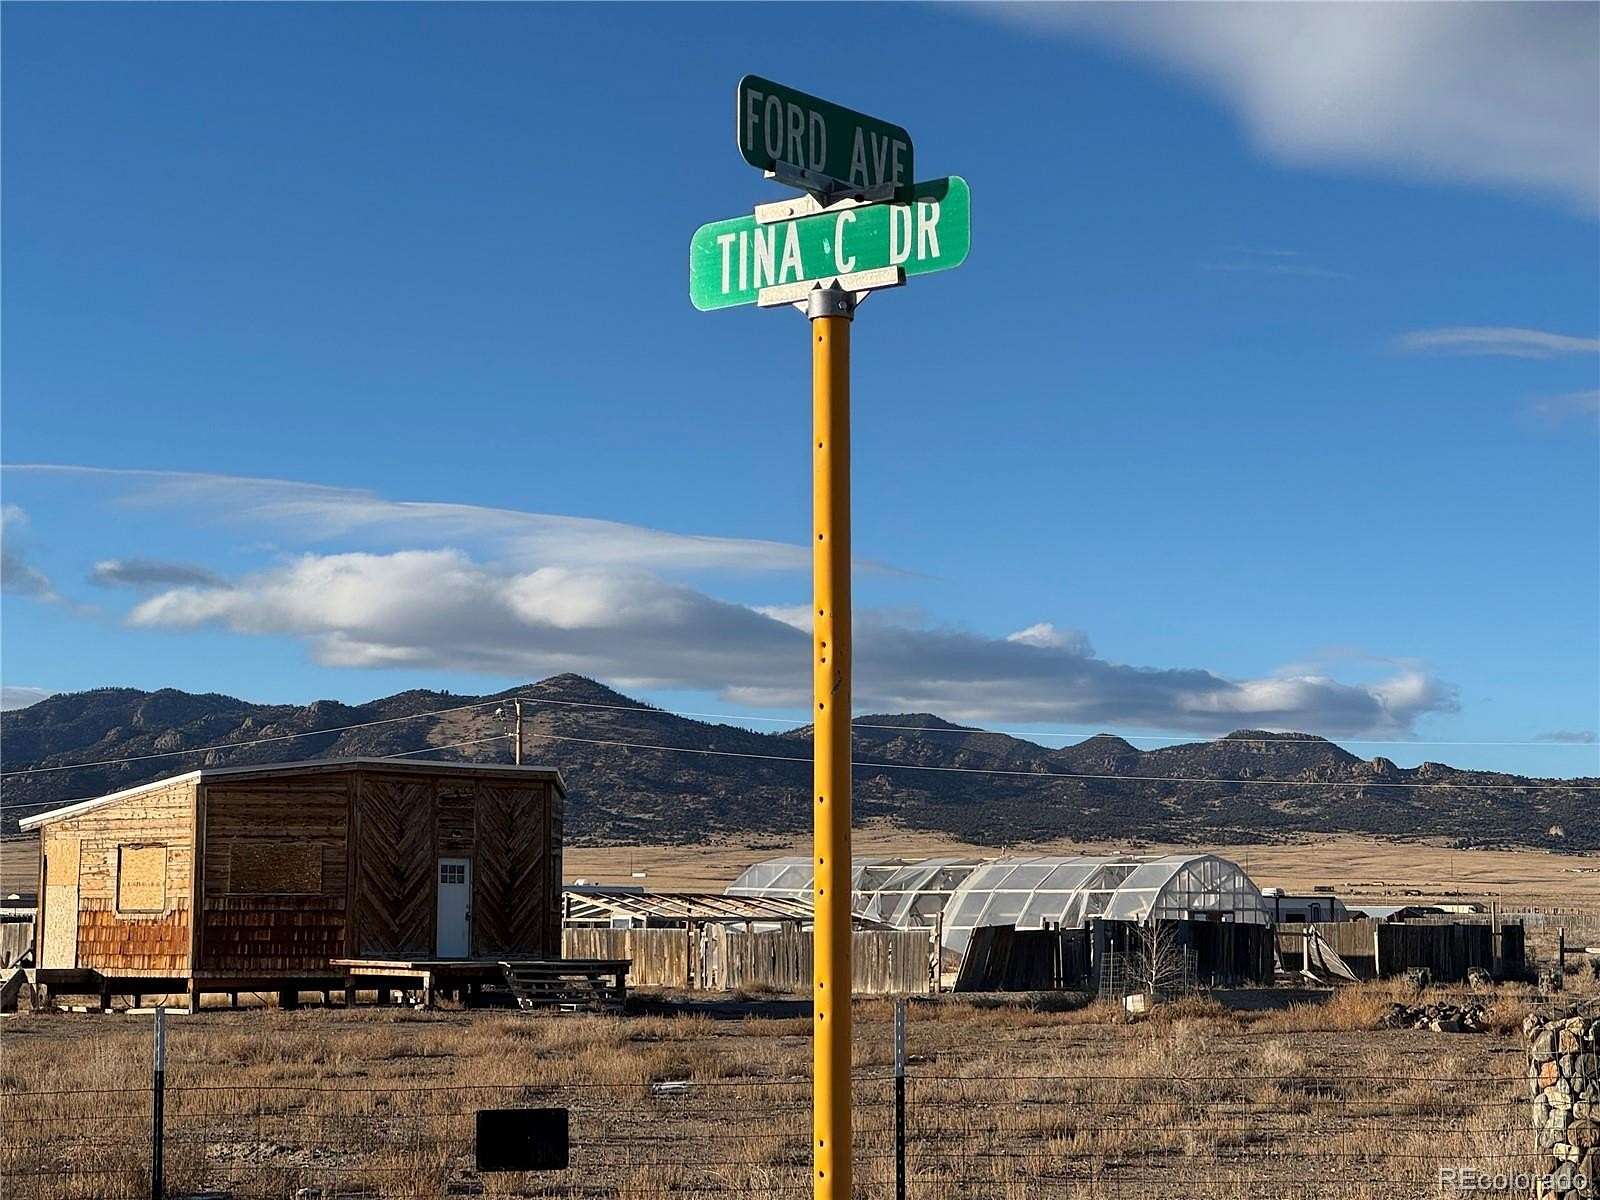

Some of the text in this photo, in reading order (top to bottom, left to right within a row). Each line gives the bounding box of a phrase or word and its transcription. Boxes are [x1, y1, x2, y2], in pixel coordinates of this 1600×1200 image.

[746, 88, 907, 188] FORD AVE
[716, 197, 941, 294] TINA C DR
